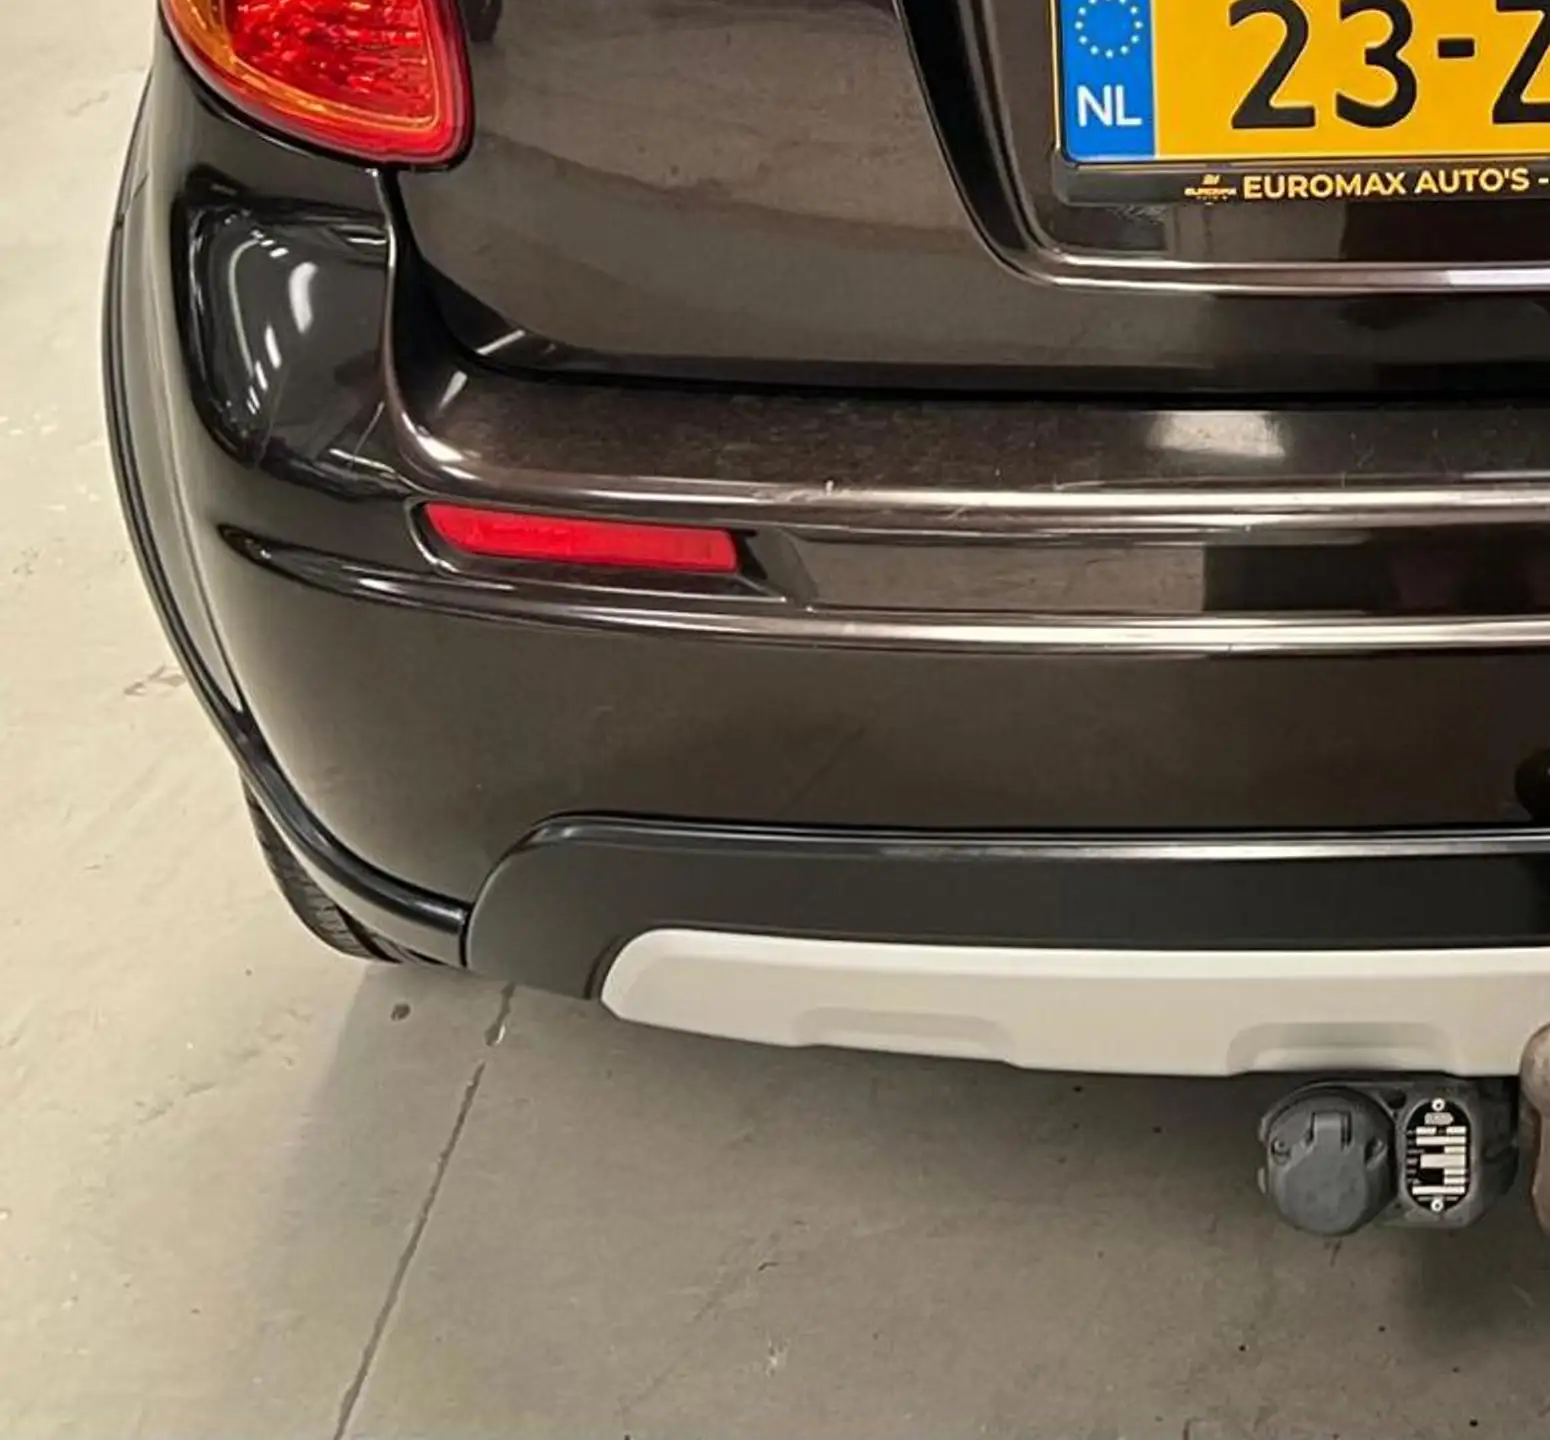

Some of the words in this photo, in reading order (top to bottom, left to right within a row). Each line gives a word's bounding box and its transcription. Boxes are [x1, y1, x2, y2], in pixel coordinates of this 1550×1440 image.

[1077, 84, 1143, 127] NL
[1243, 172, 1407, 199] EUROMAX
[1414, 167, 1530, 194] AUTO'S
